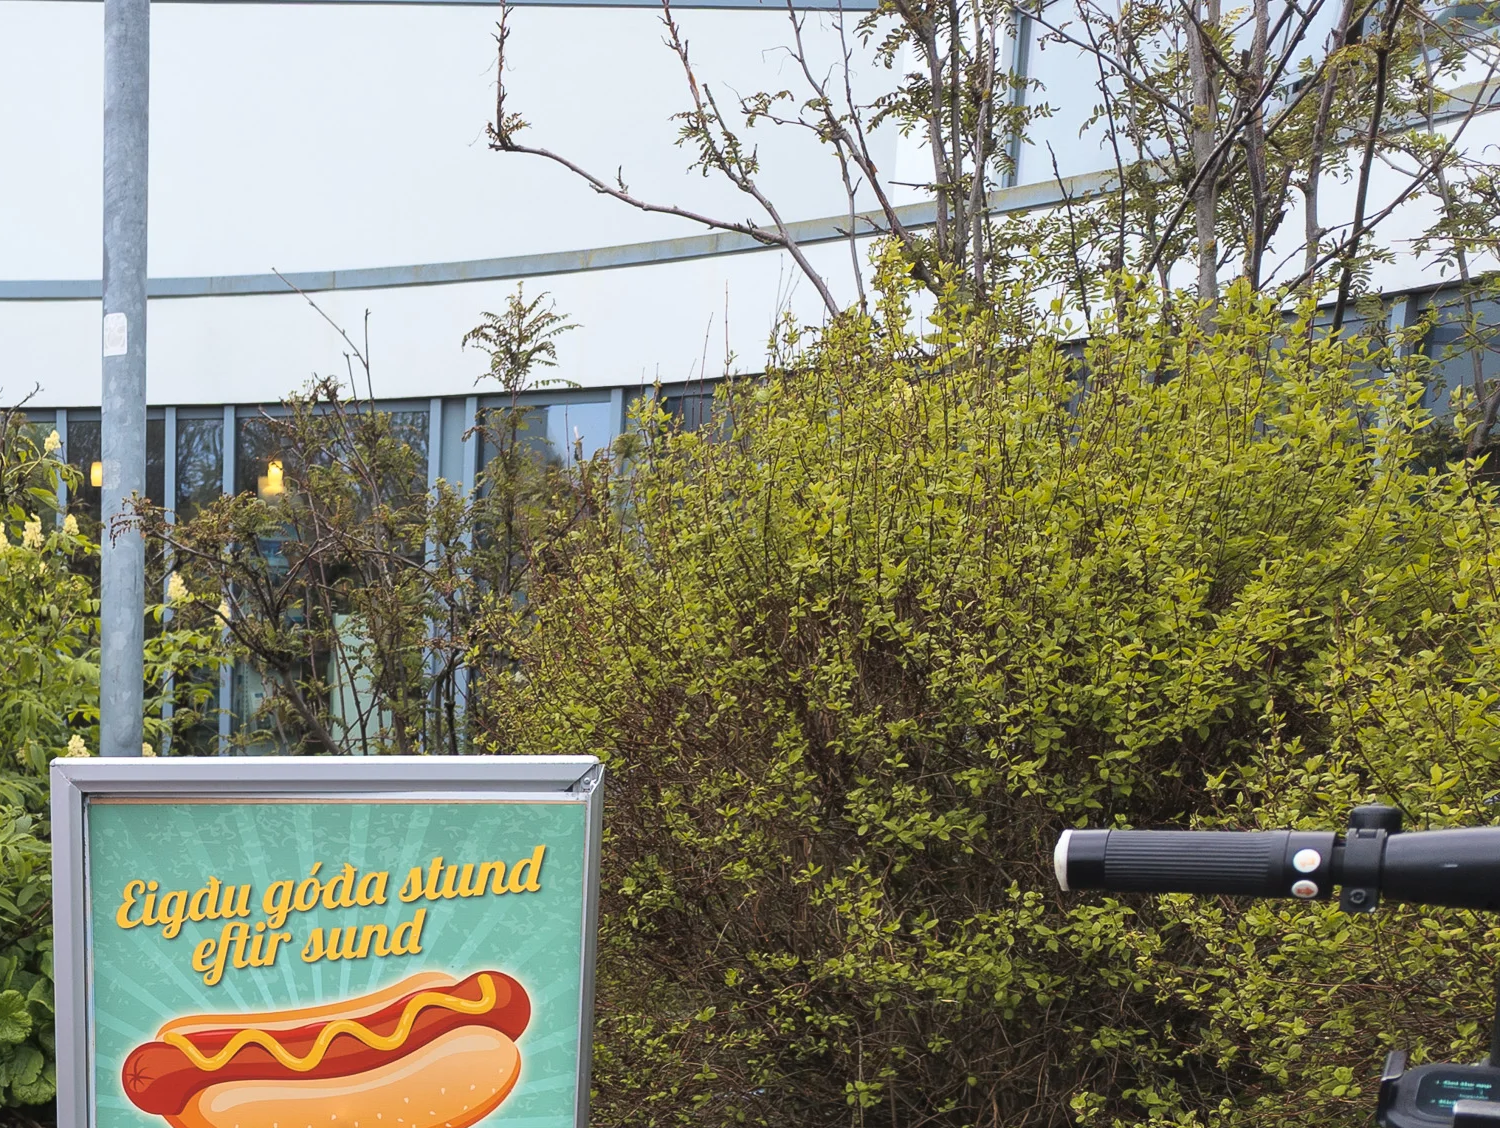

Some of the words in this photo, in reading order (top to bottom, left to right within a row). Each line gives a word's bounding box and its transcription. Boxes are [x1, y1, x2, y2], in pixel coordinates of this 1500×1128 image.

[116, 877, 251, 939] Eigðu
[262, 862, 389, 929] góða
[399, 845, 546, 903] stund
[192, 921, 291, 986] eftir
[302, 908, 426, 964] sund
